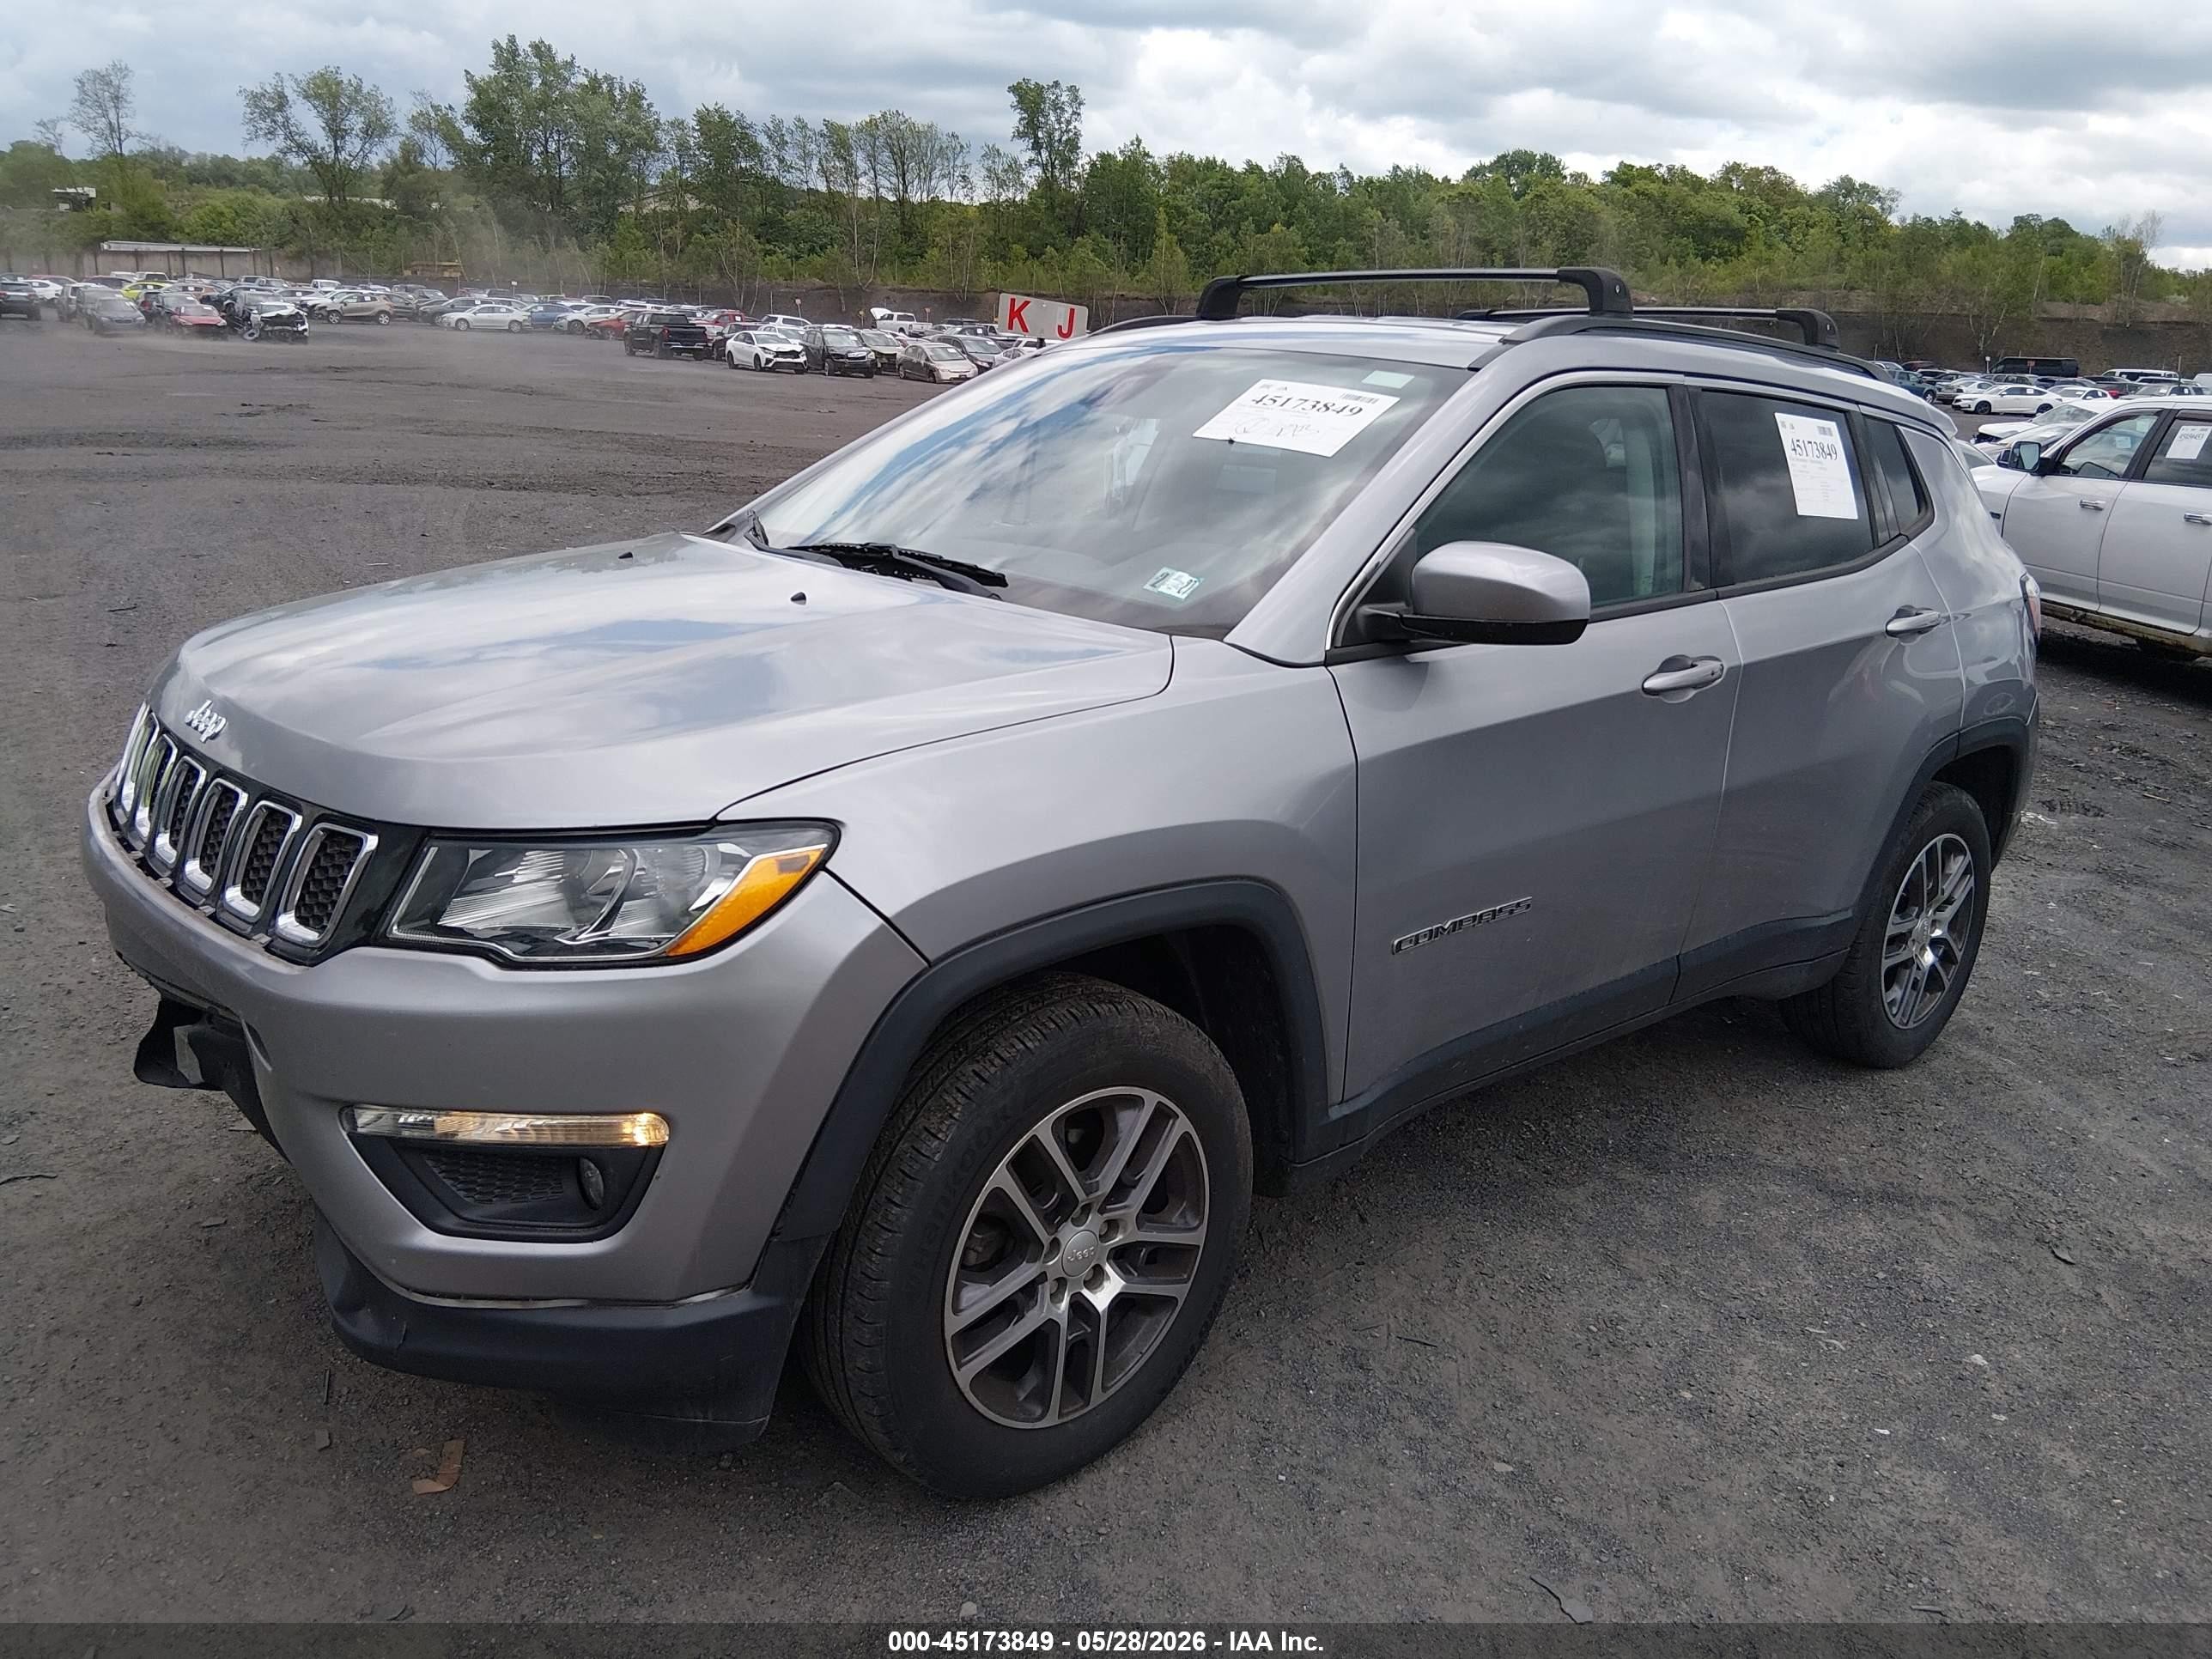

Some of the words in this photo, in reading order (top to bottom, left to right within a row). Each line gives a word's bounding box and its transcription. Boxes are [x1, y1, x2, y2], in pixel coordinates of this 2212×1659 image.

[1007, 297, 1031, 333] K
[1057, 307, 1075, 339] J
[1251, 393, 1364, 416] 45173849
[1790, 438, 1838, 460] 45173849
[184, 698, 227, 744] Jeep
[1391, 896, 1533, 955] COMPASS
[1066, 1245, 1095, 1261] Jeep
